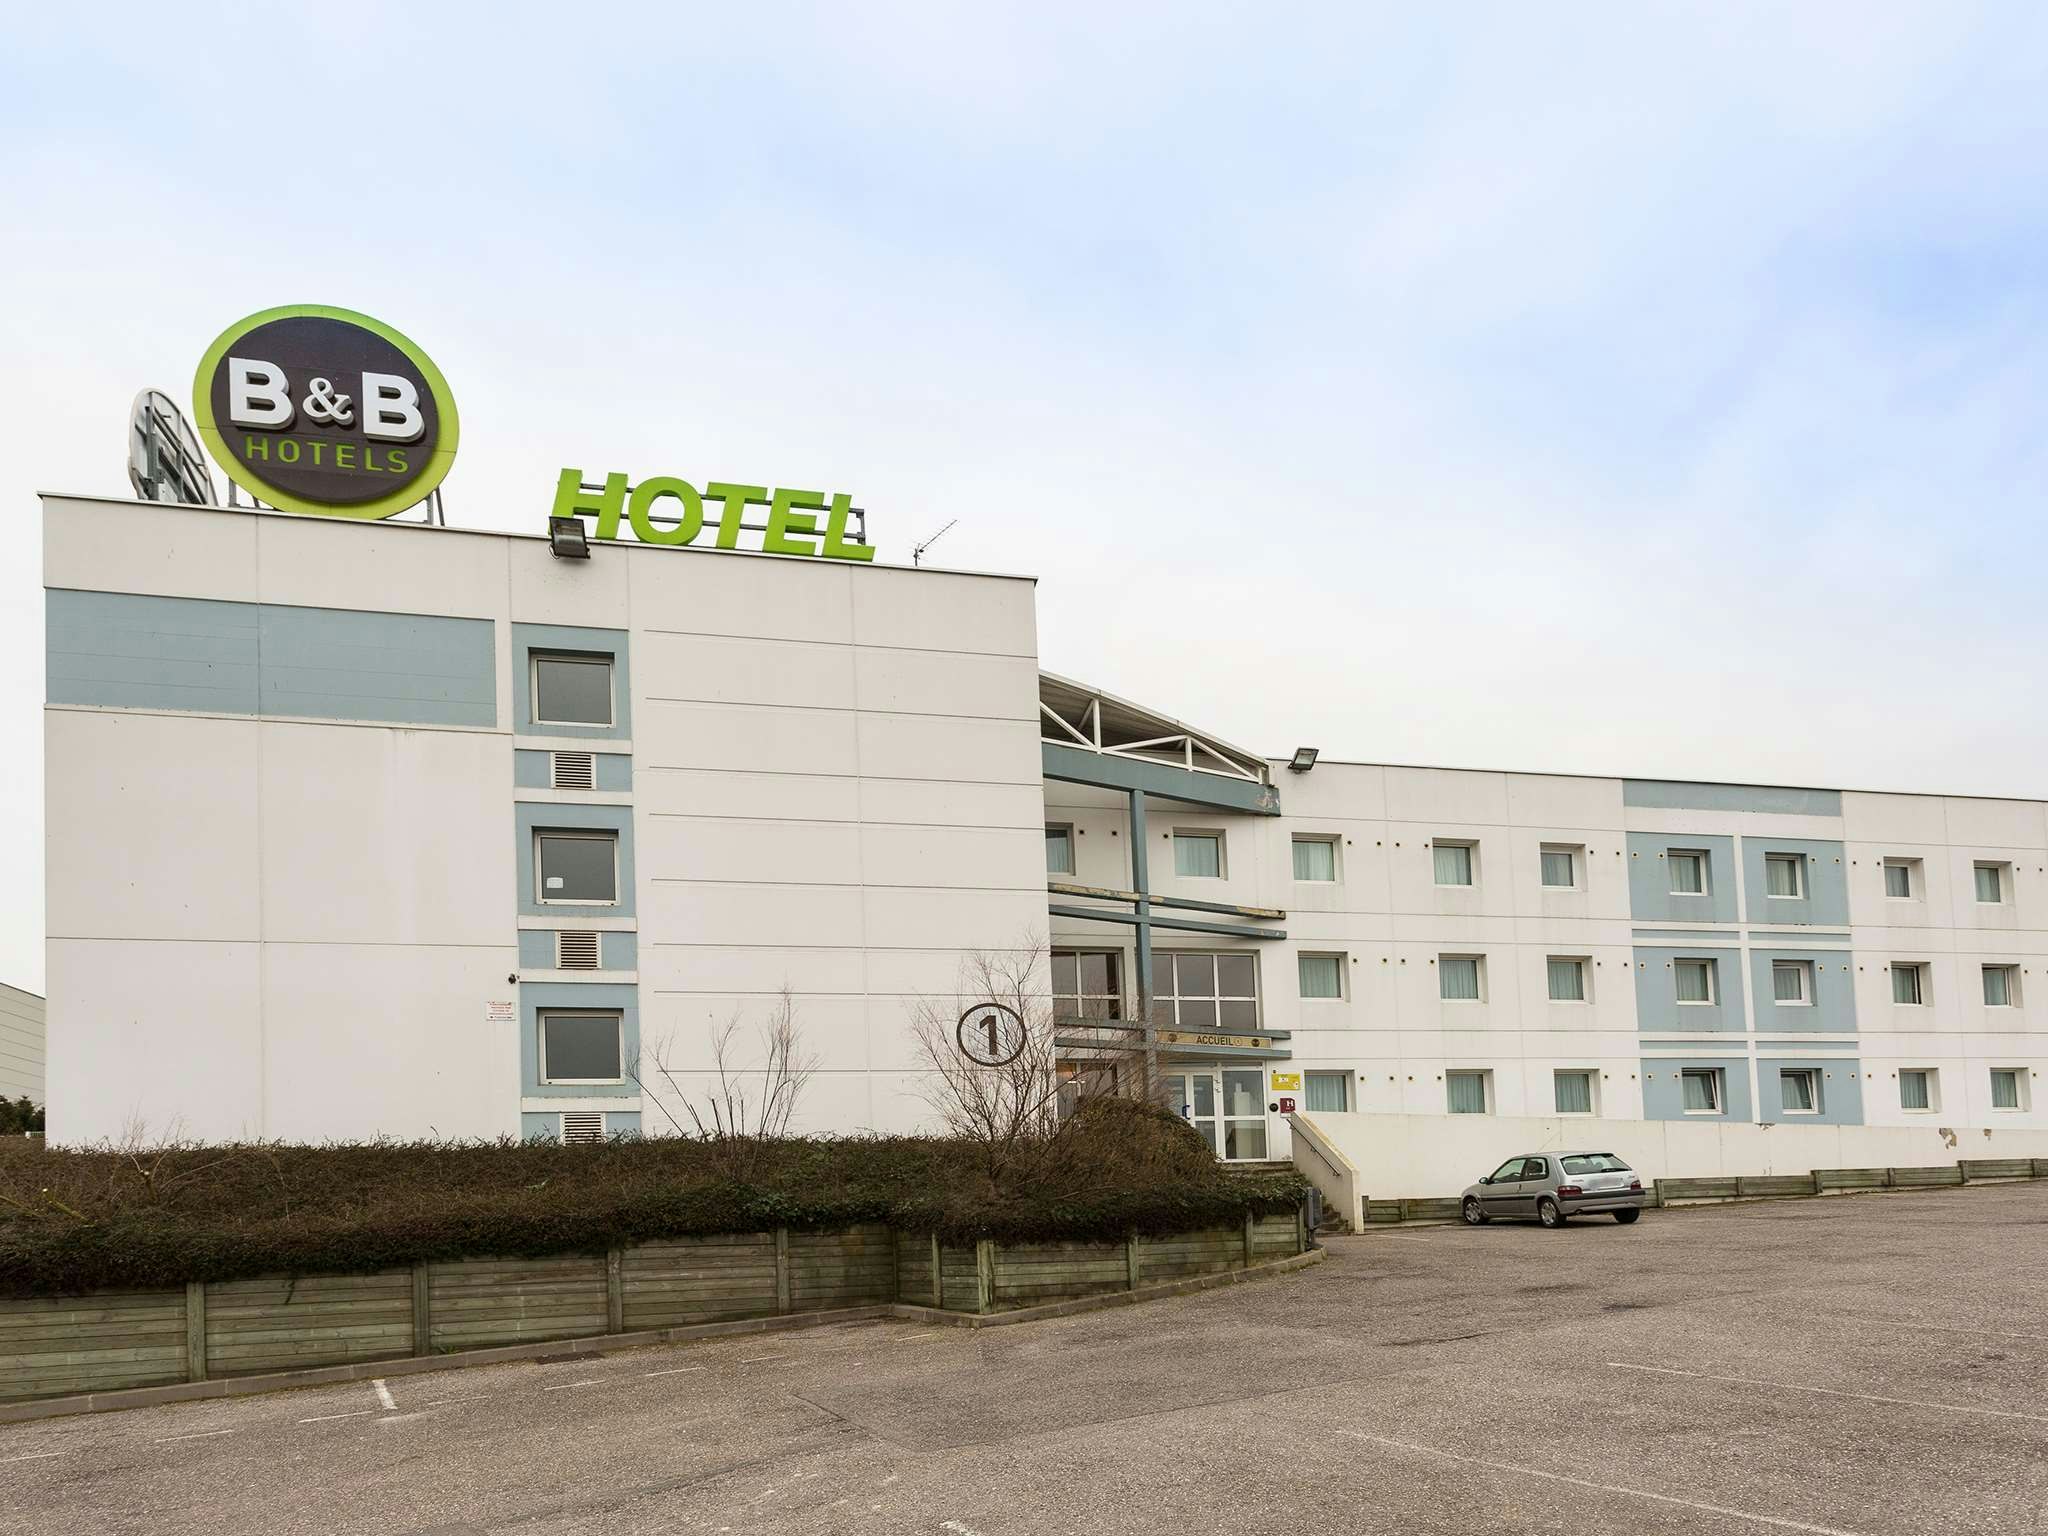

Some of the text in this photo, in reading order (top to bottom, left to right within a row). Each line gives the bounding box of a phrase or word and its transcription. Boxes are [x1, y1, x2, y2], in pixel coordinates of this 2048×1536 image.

[245, 435, 409, 473] HOTELS
[548, 467, 876, 562] HOTEL
[980, 1015, 998, 1055] 1
[1196, 1035, 1234, 1046] ACCUEIL
